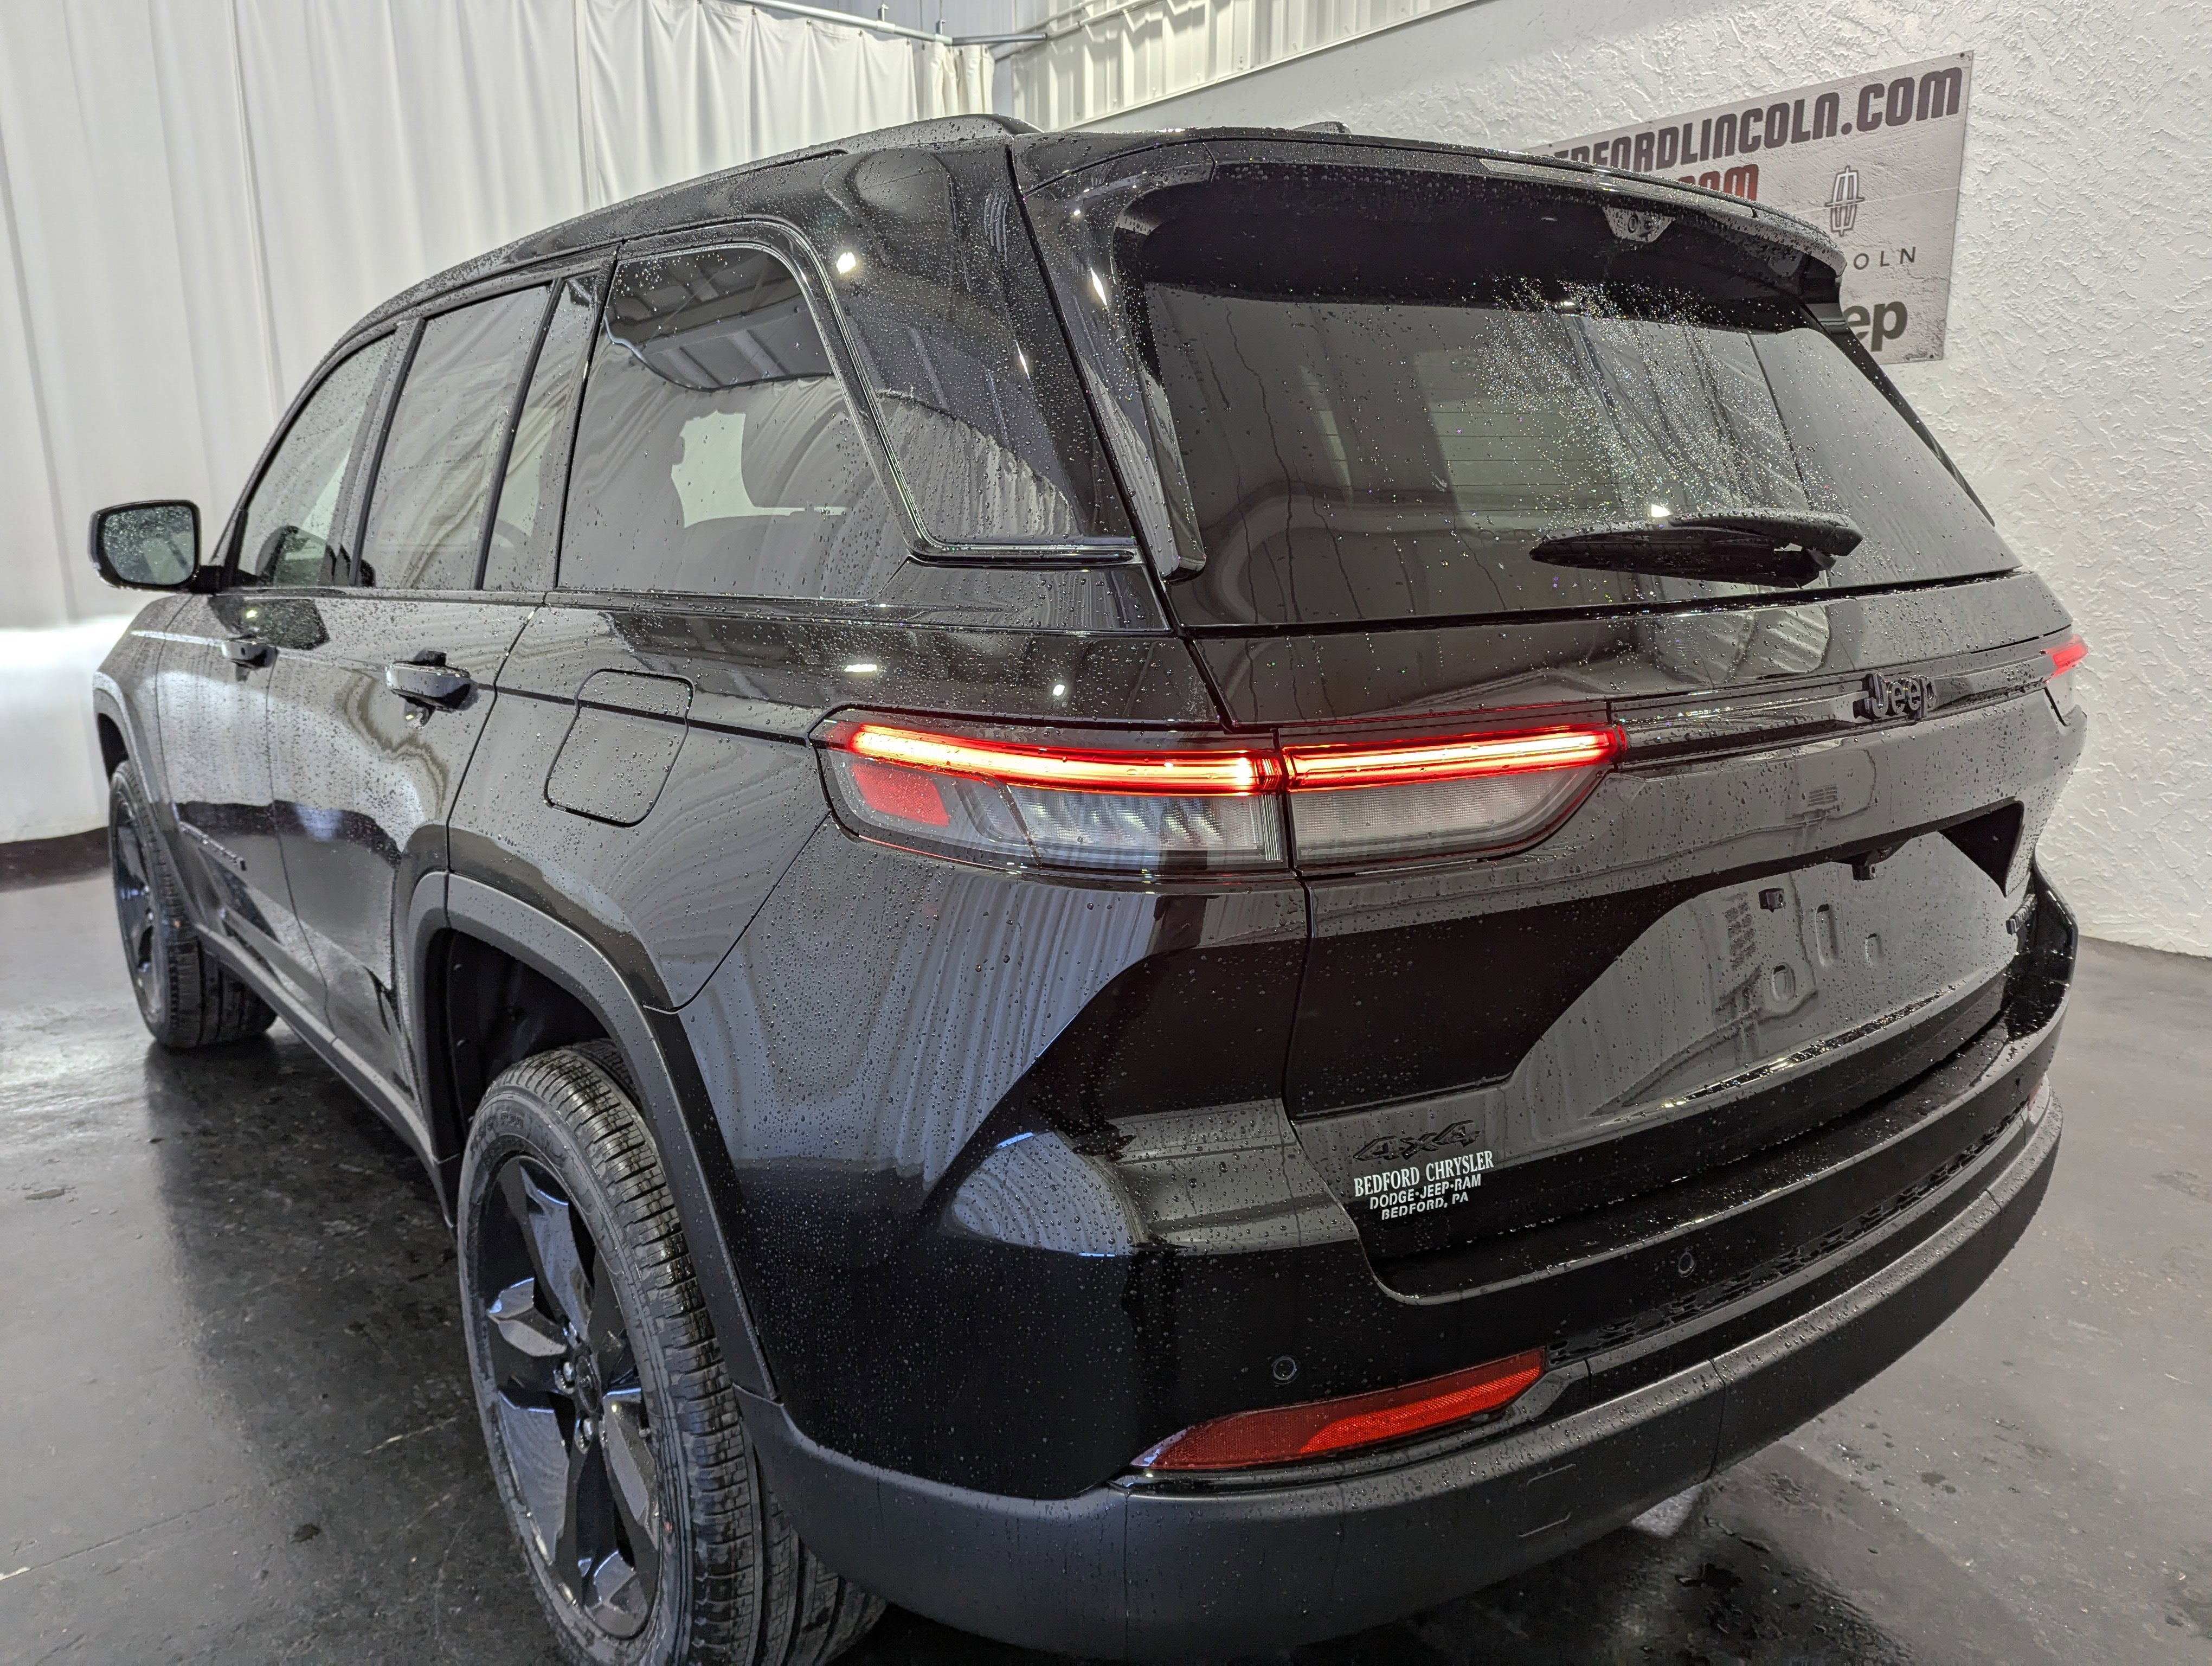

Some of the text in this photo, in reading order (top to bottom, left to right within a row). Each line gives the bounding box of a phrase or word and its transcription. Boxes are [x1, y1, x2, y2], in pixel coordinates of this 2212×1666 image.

[1541, 67, 1963, 173] FORDLINCOLN.COM
[1843, 300, 1908, 353] ep
[1865, 672, 1937, 720] Jeep
[1353, 1150, 1494, 1197] BEDFORD CHRYSLER
[1381, 1191, 1469, 1220] BEDFORD, PA
